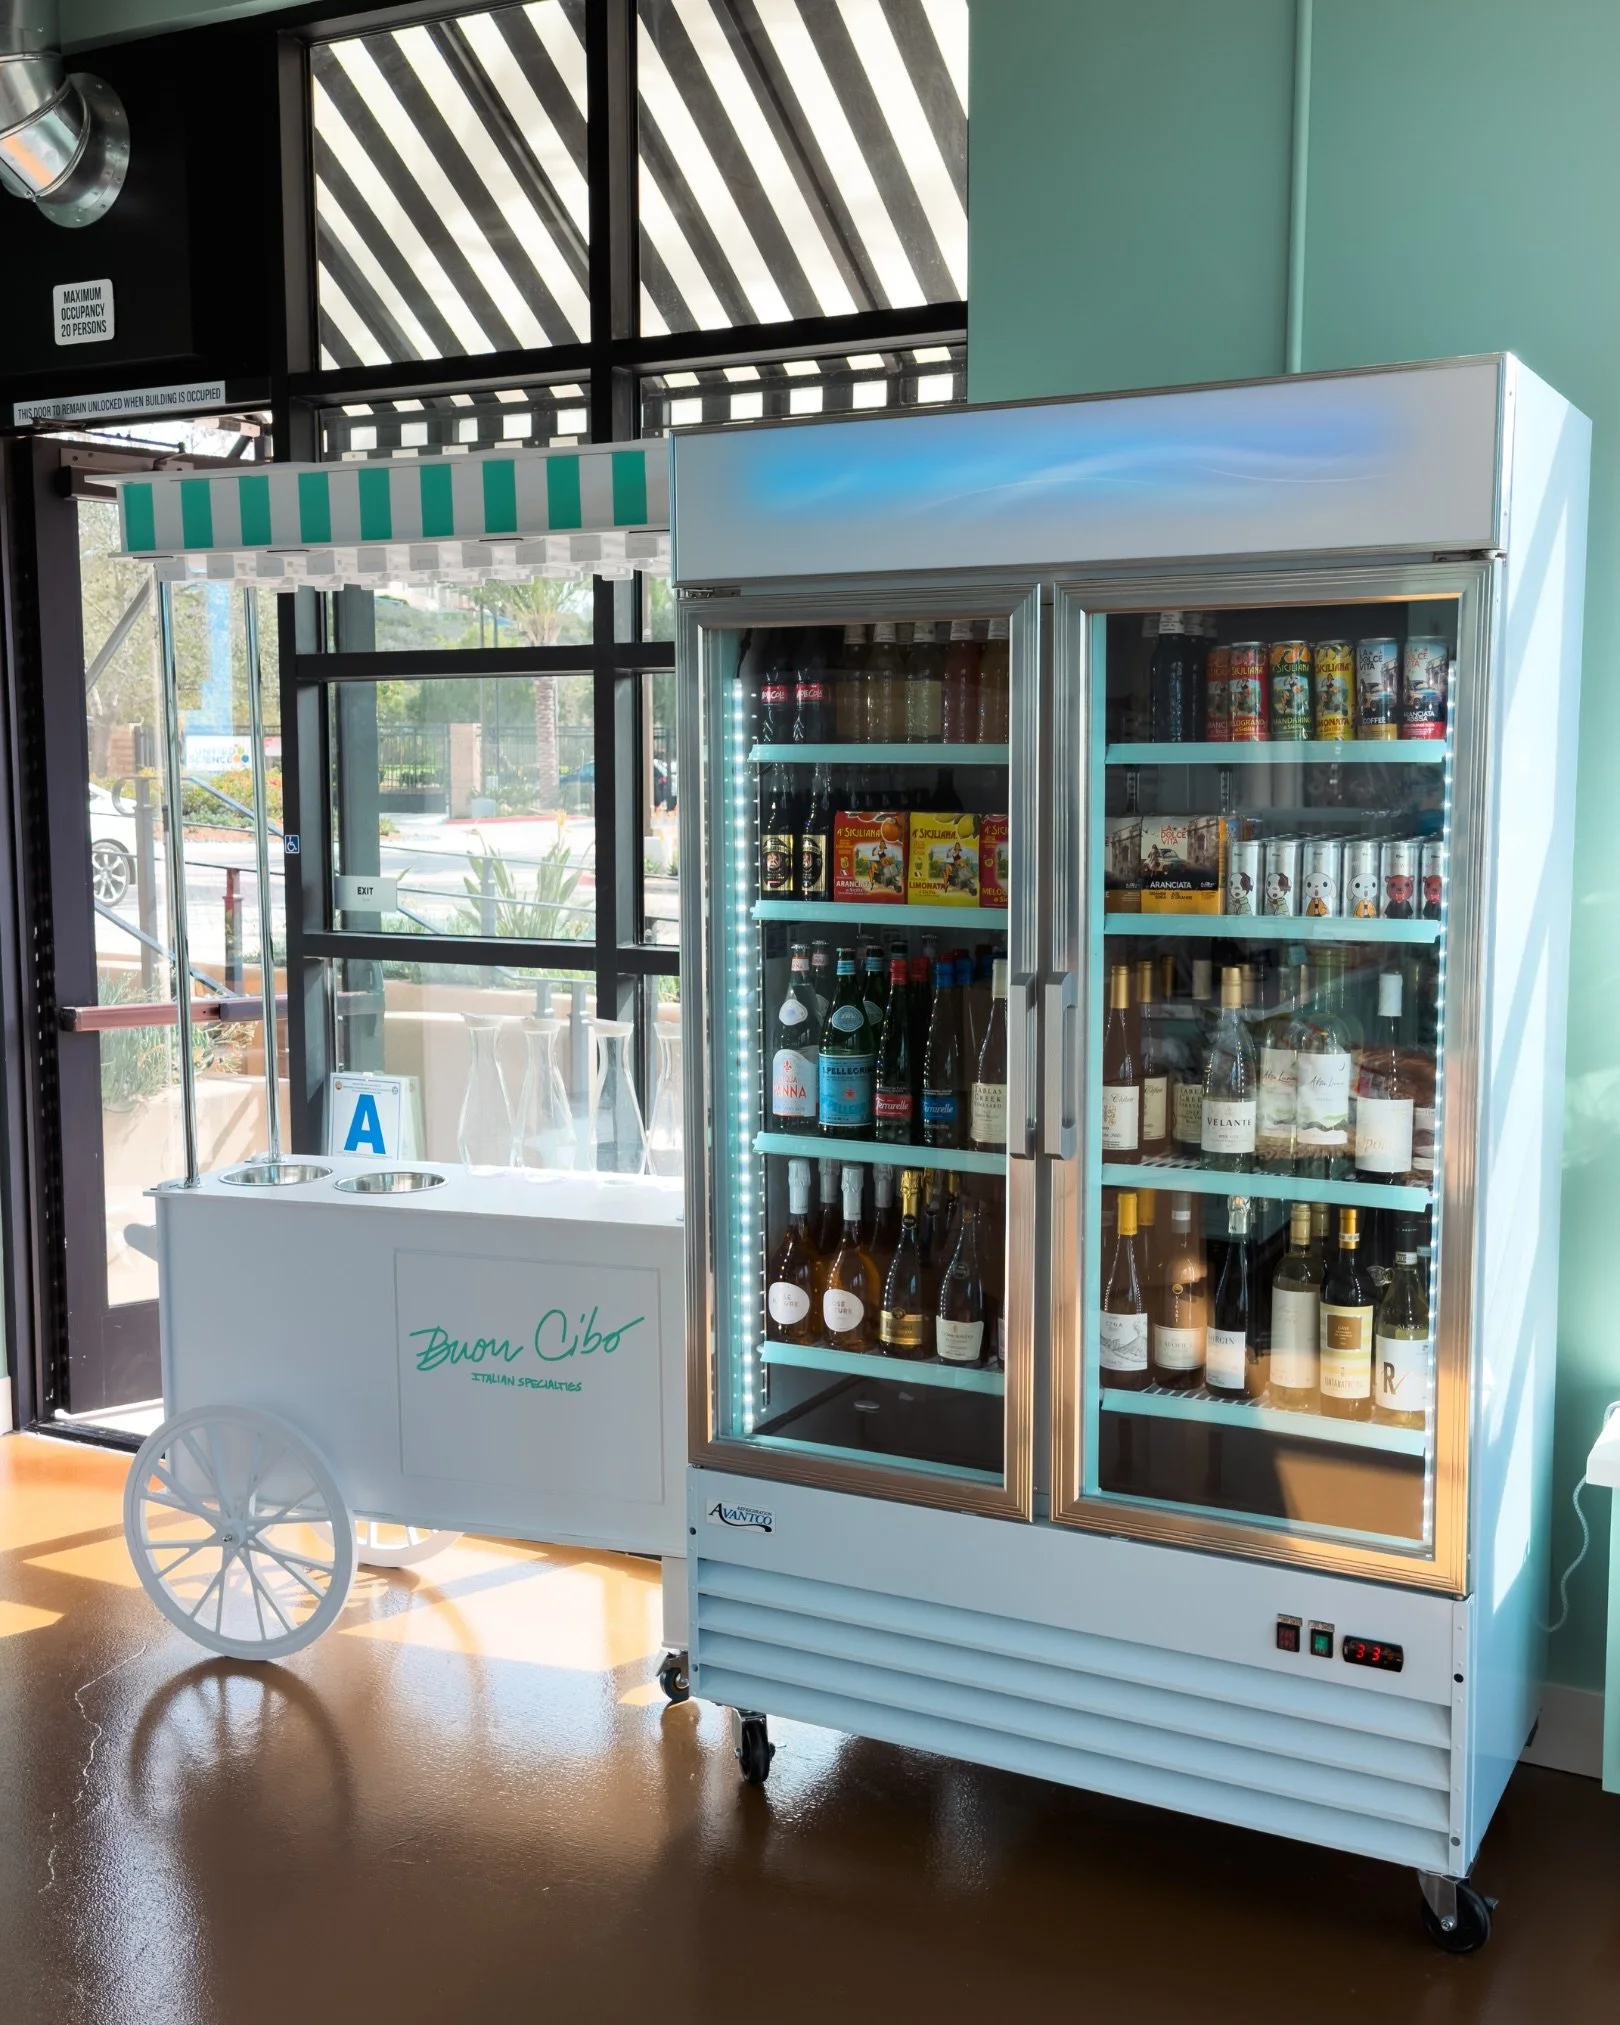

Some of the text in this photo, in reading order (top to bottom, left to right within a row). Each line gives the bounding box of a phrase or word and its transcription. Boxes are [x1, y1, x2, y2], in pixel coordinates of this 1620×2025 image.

[63, 286, 102, 304] MAXIMUM
[61, 302, 105, 320] OCCUPANCY
[61, 319, 107, 338] 20 PERSONS
[18, 387, 221, 420] THIS DOOR TO REMAIN UNLOCKED WHEN BUILDING IS OCCUPIED
[1161, 824, 1173, 832] LA
[1161, 831, 1187, 839] DOLCE
[1161, 838, 1179, 846] VITA
[357, 886, 374, 896] EXIT
[1150, 881, 1192, 889] ARANCIATA
[974, 1093, 1001, 1102] CREEK
[343, 1093, 386, 1155] A
[1207, 1117, 1252, 1127] VELANTE
[409, 1305, 645, 1371] Buon Cibo
[471, 1372, 583, 1393] ITALIAN SPECIALTIES
[708, 1502, 773, 1534] AVANTCO
